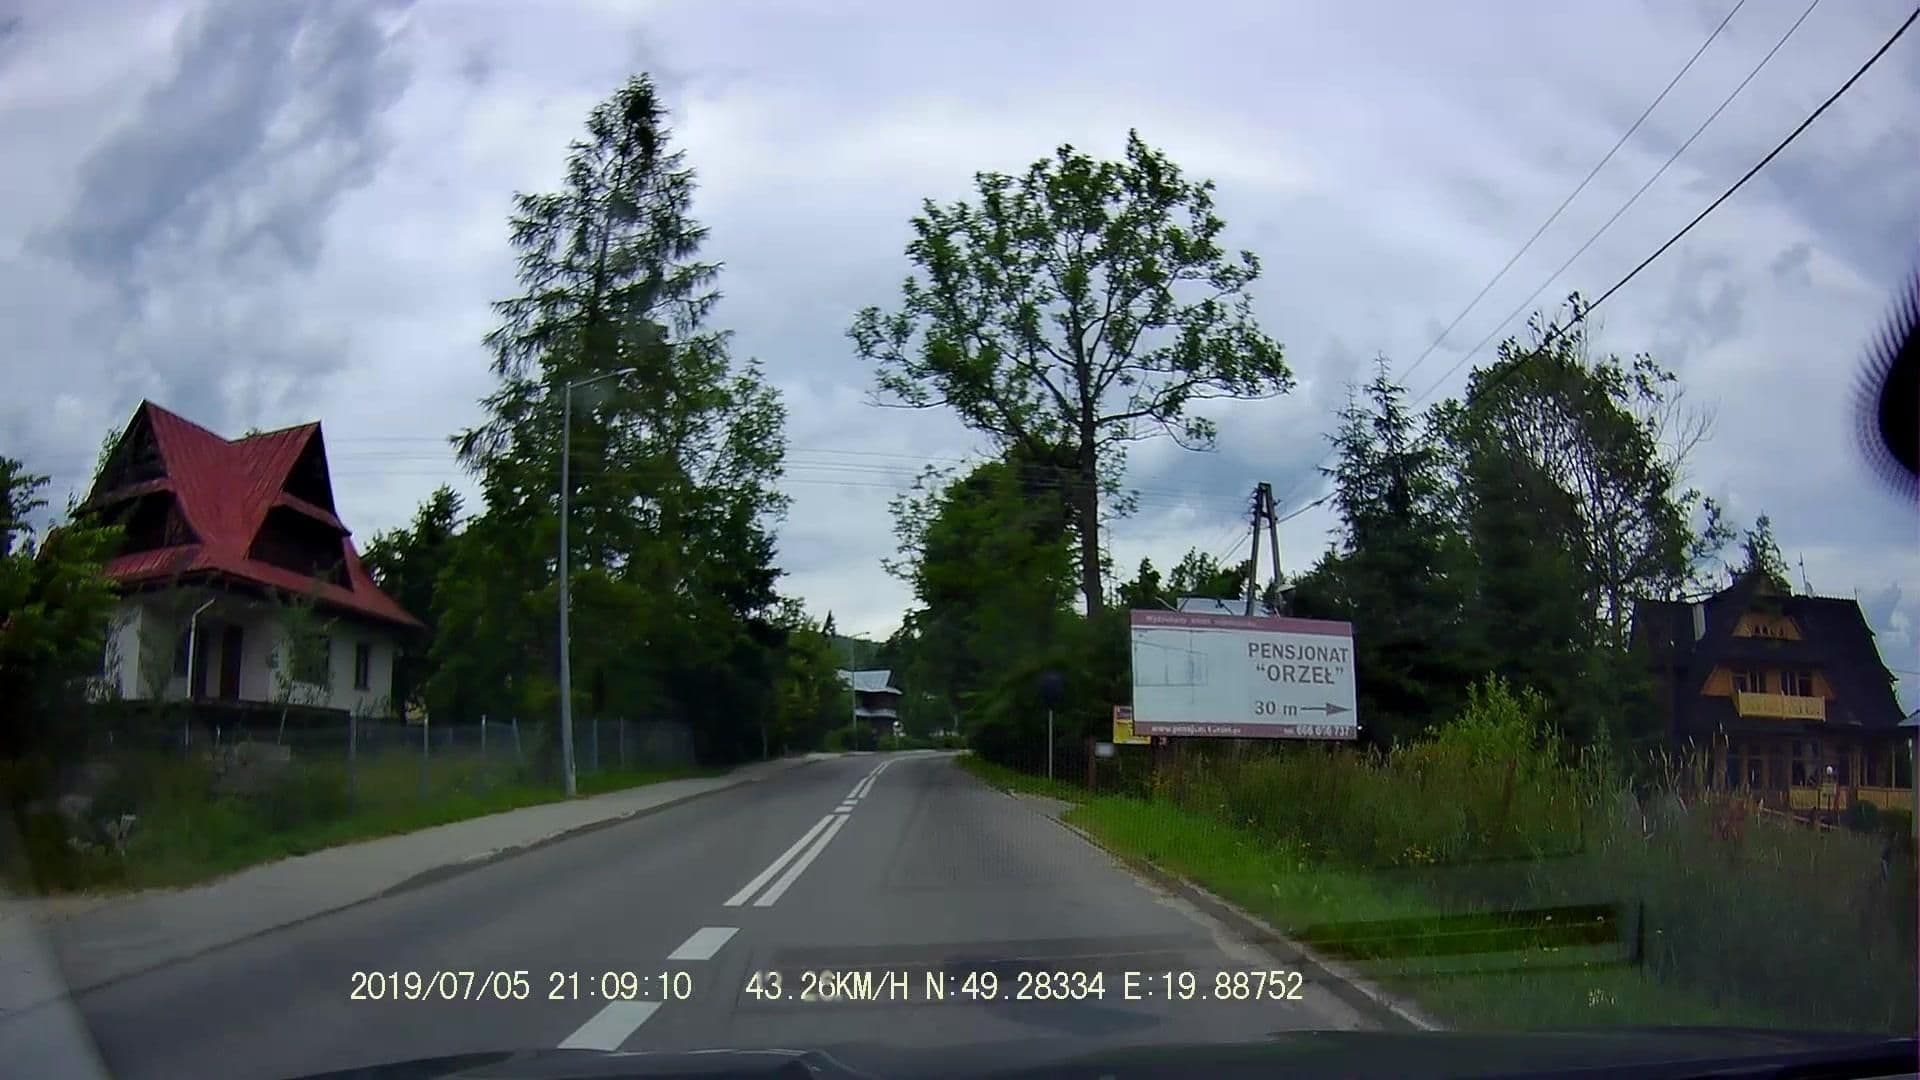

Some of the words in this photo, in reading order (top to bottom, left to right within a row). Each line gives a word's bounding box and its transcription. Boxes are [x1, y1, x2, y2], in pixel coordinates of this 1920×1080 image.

[1248, 642, 1349, 663] PENSJONAT
[1255, 700, 1276, 716] 30
[1283, 704, 1298, 716] m
